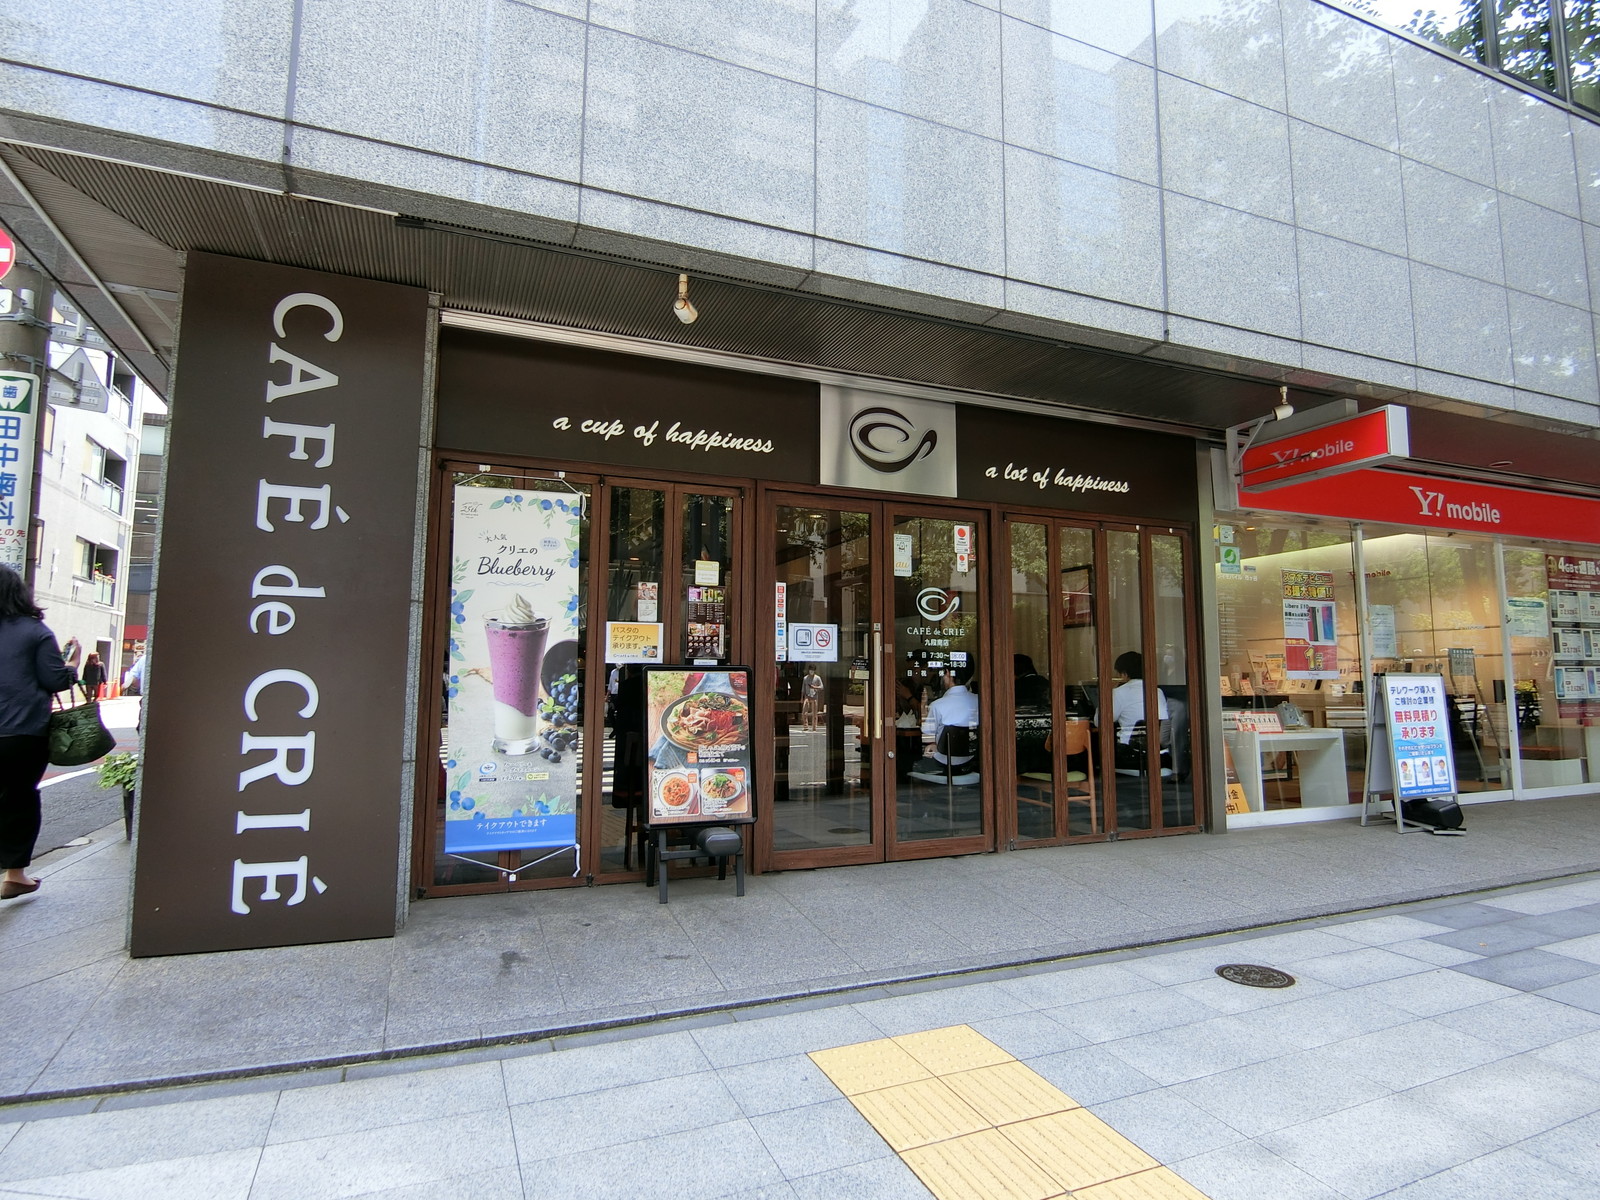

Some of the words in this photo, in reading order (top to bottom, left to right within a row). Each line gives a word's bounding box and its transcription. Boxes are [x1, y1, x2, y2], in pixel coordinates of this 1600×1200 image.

[255, 292, 350, 532] CAFÉ
[553, 416, 571, 431] a
[581, 419, 625, 440] cup
[633, 421, 660, 447] of
[666, 422, 775, 454] happiness
[985, 466, 999, 479] a
[1004, 462, 1028, 482] lot
[1032, 467, 1051, 489] of
[1054, 468, 1130, 493] happiness
[497, 545, 538, 555] クリエの
[477, 556, 555, 581] Blueberry
[250, 564, 326, 635] de
[612, 634, 651, 642] テイクアウト
[907, 626, 932, 636] CAFÉ
[933, 628, 941, 636] de
[943, 626, 965, 636] CRIÉ
[1394, 709, 1438, 723] 無料見積り
[1401, 725, 1436, 739] 承ります
[231, 668, 327, 915] CRIÉ
[476, 818, 547, 831] テイクアウトできます
